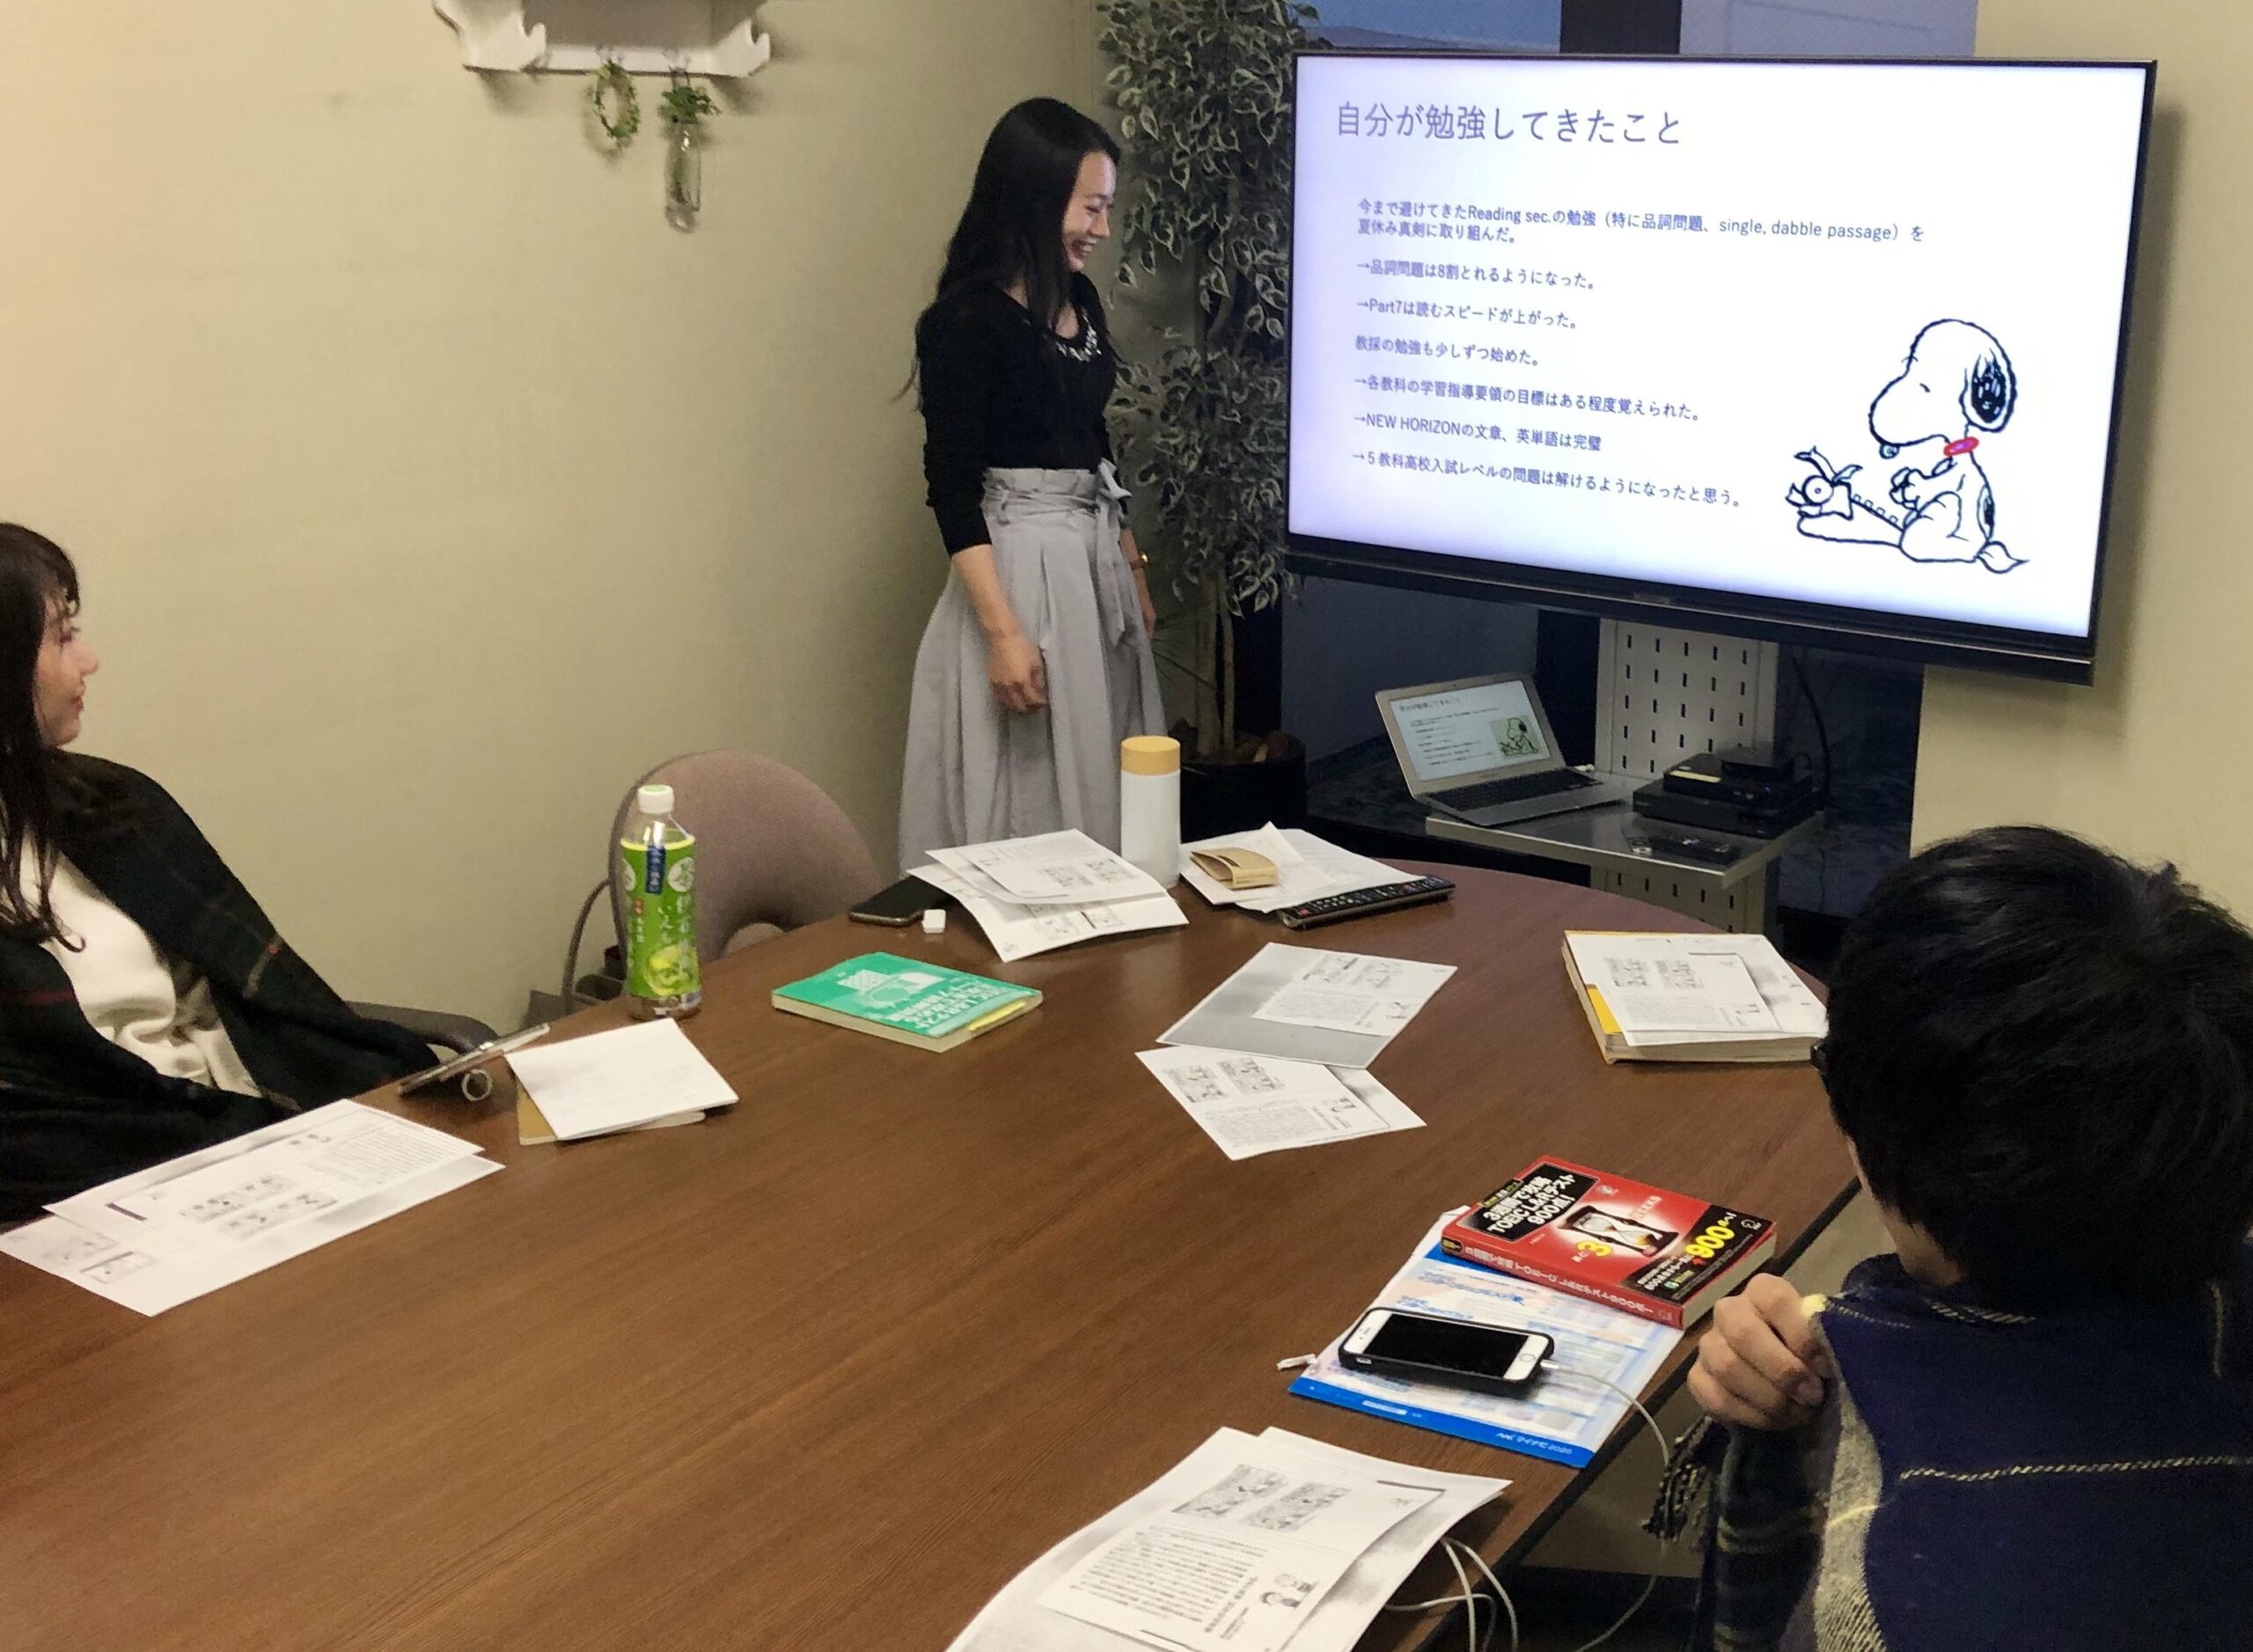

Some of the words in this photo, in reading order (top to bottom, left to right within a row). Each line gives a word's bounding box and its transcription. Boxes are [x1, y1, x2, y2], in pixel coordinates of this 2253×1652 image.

[1338, 101, 1680, 144] 自分が勉強してきたこと
[1358, 218, 1515, 244] 夏休み真剣に取り組んだ。
[1772, 221, 1822, 238] dabble
[1355, 334, 1538, 366] 教採の勉強も少しずつ始めた。
[1487, 1208, 1530, 1233] TOEIC
